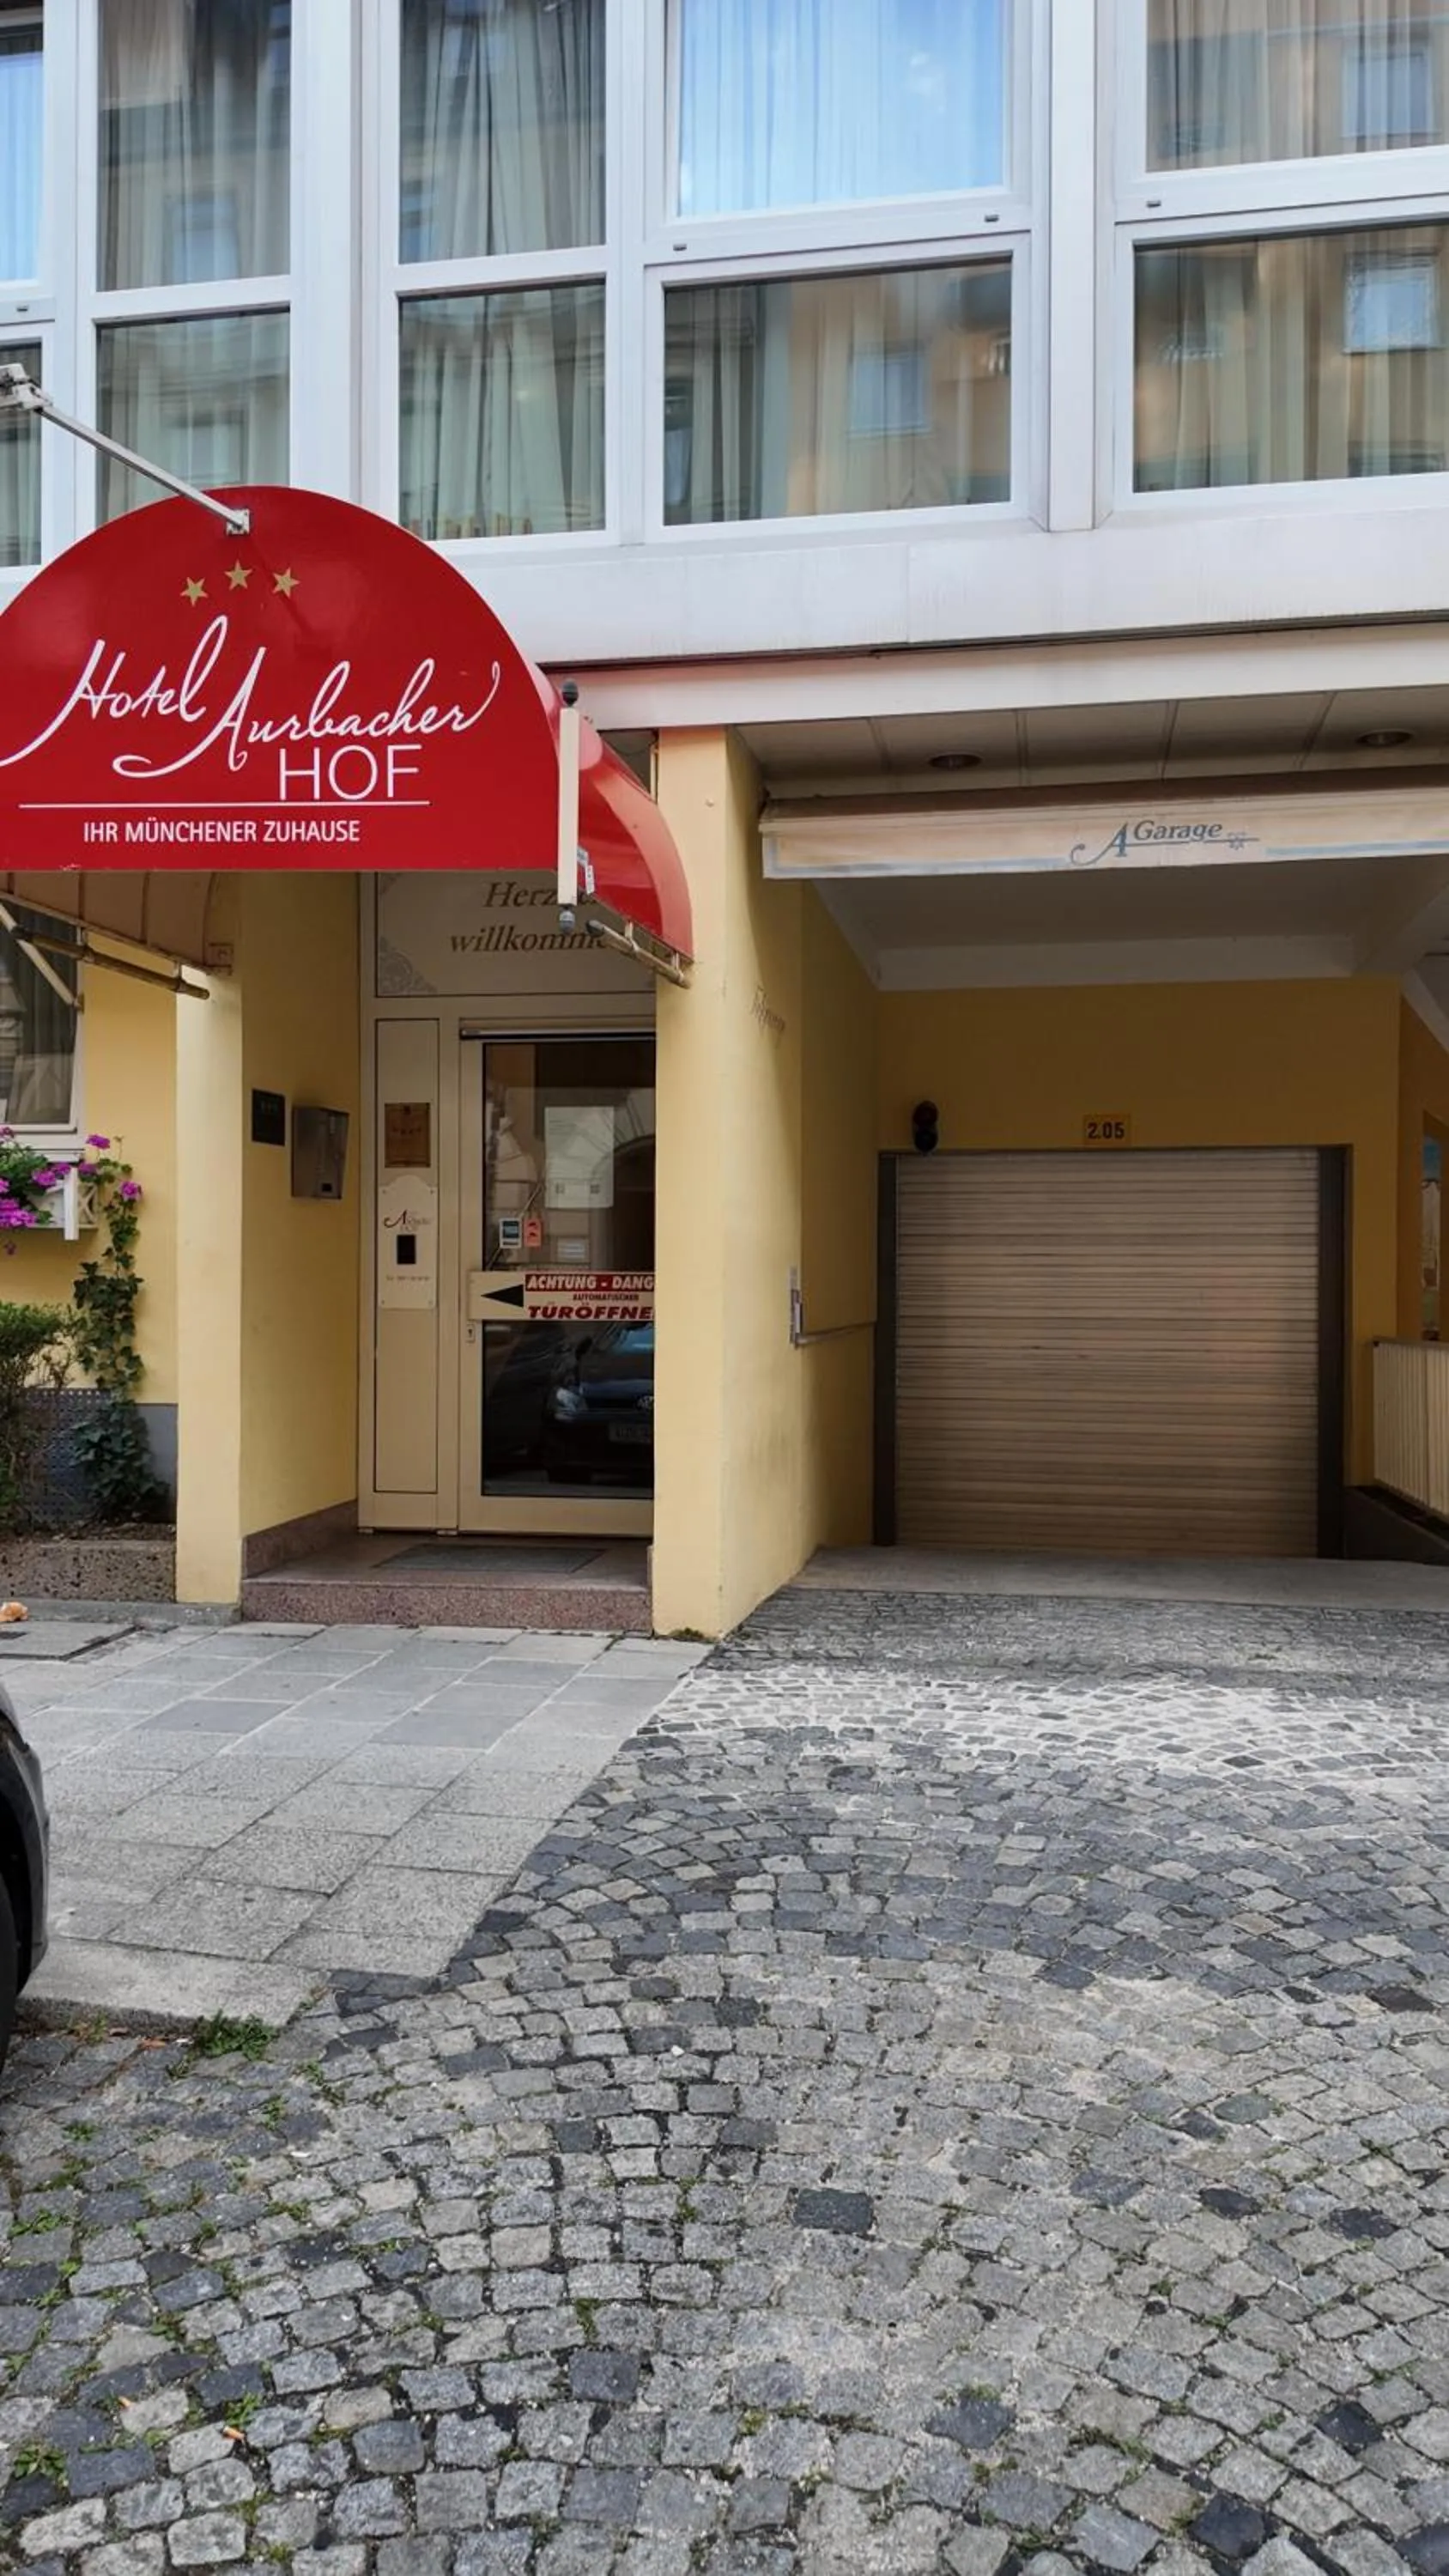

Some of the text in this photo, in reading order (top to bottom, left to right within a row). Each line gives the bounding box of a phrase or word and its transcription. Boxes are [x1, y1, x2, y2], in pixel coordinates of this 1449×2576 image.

[0, 616, 500, 777] Hotel Aurbacher
[279, 744, 422, 800] HOF
[83, 817, 360, 842] IHR MÜNCHENER ZUHAUSE
[1133, 820, 1222, 841] Garage
[1087, 1121, 1125, 1139] 2.05
[527, 1275, 597, 1290] ACHTUNG
[612, 1275, 654, 1290] DANG
[528, 1301, 654, 1320] TÜRÖFFNE
